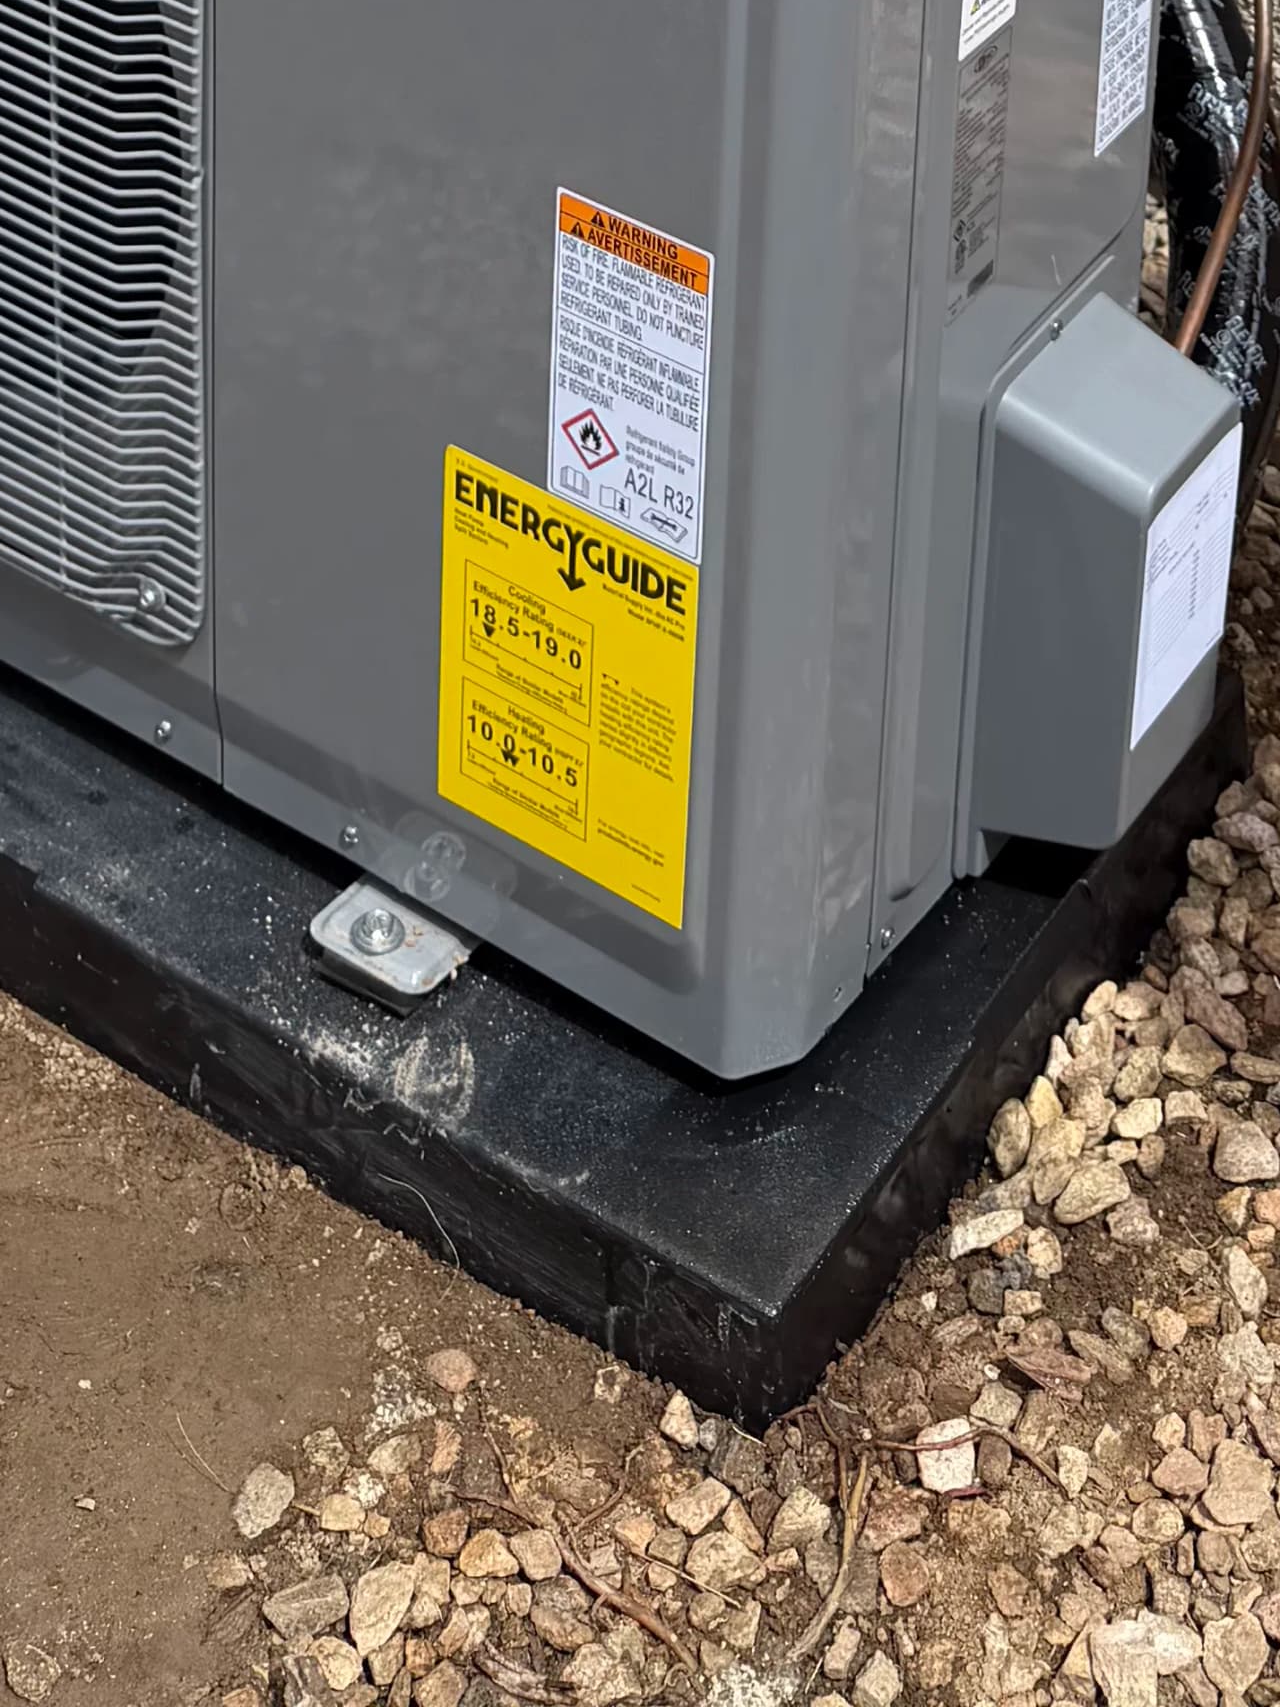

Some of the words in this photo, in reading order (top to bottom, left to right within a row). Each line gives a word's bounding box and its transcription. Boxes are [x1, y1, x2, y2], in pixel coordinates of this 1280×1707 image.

[580, 243, 588, 259] OF
[587, 226, 698, 289] AVERTISSEMENT
[608, 215, 678, 260] WARNING
[560, 289, 611, 327] REFRIGERANT
[561, 271, 590, 298] SERVICE
[636, 305, 647, 324] DO
[649, 311, 664, 332] NOT
[666, 319, 703, 350] PUNCTURE
[584, 263, 593, 281] TO
[595, 268, 604, 286] BE
[642, 289, 660, 311] ONLY
[662, 298, 673, 317] BY
[624, 464, 658, 503] A2L
[663, 483, 694, 520] R32
[455, 468, 686, 616] ENERGYGUIDE
[473, 579, 519, 615] Efficiency
[522, 604, 554, 634] Rating
[508, 584, 546, 616] Cooling
[472, 698, 517, 735] Efficiency
[521, 725, 552, 753] Rating
[507, 704, 544, 736] Heating
[467, 711, 577, 789] 10.0-10.5
